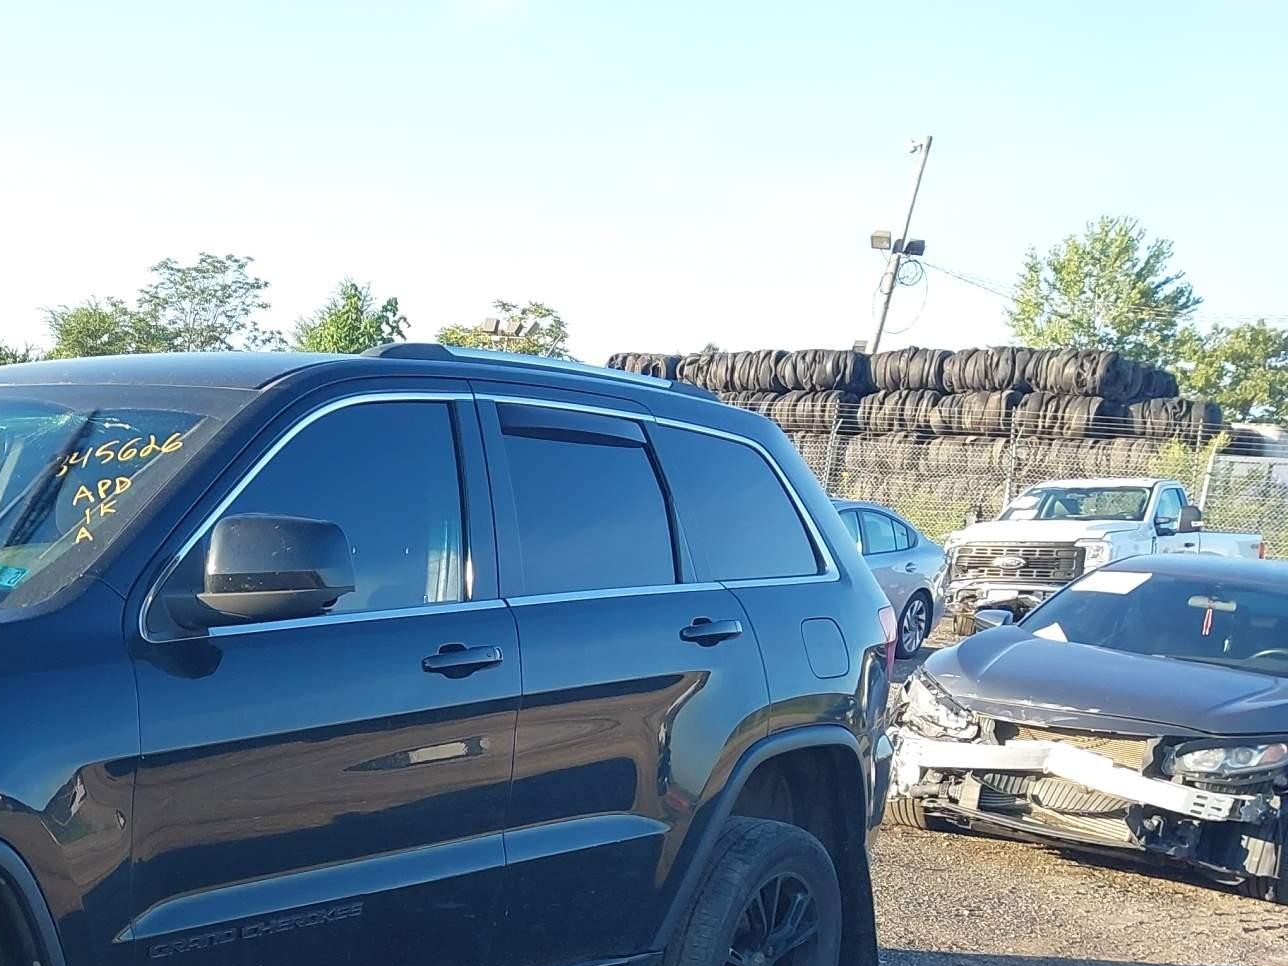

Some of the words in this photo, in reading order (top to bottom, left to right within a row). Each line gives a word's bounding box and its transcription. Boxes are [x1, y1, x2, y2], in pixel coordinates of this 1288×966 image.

[73, 476, 132, 506] APD
[148, 928, 237, 959] GRAND
[241, 901, 364, 940] CHEROKEE
